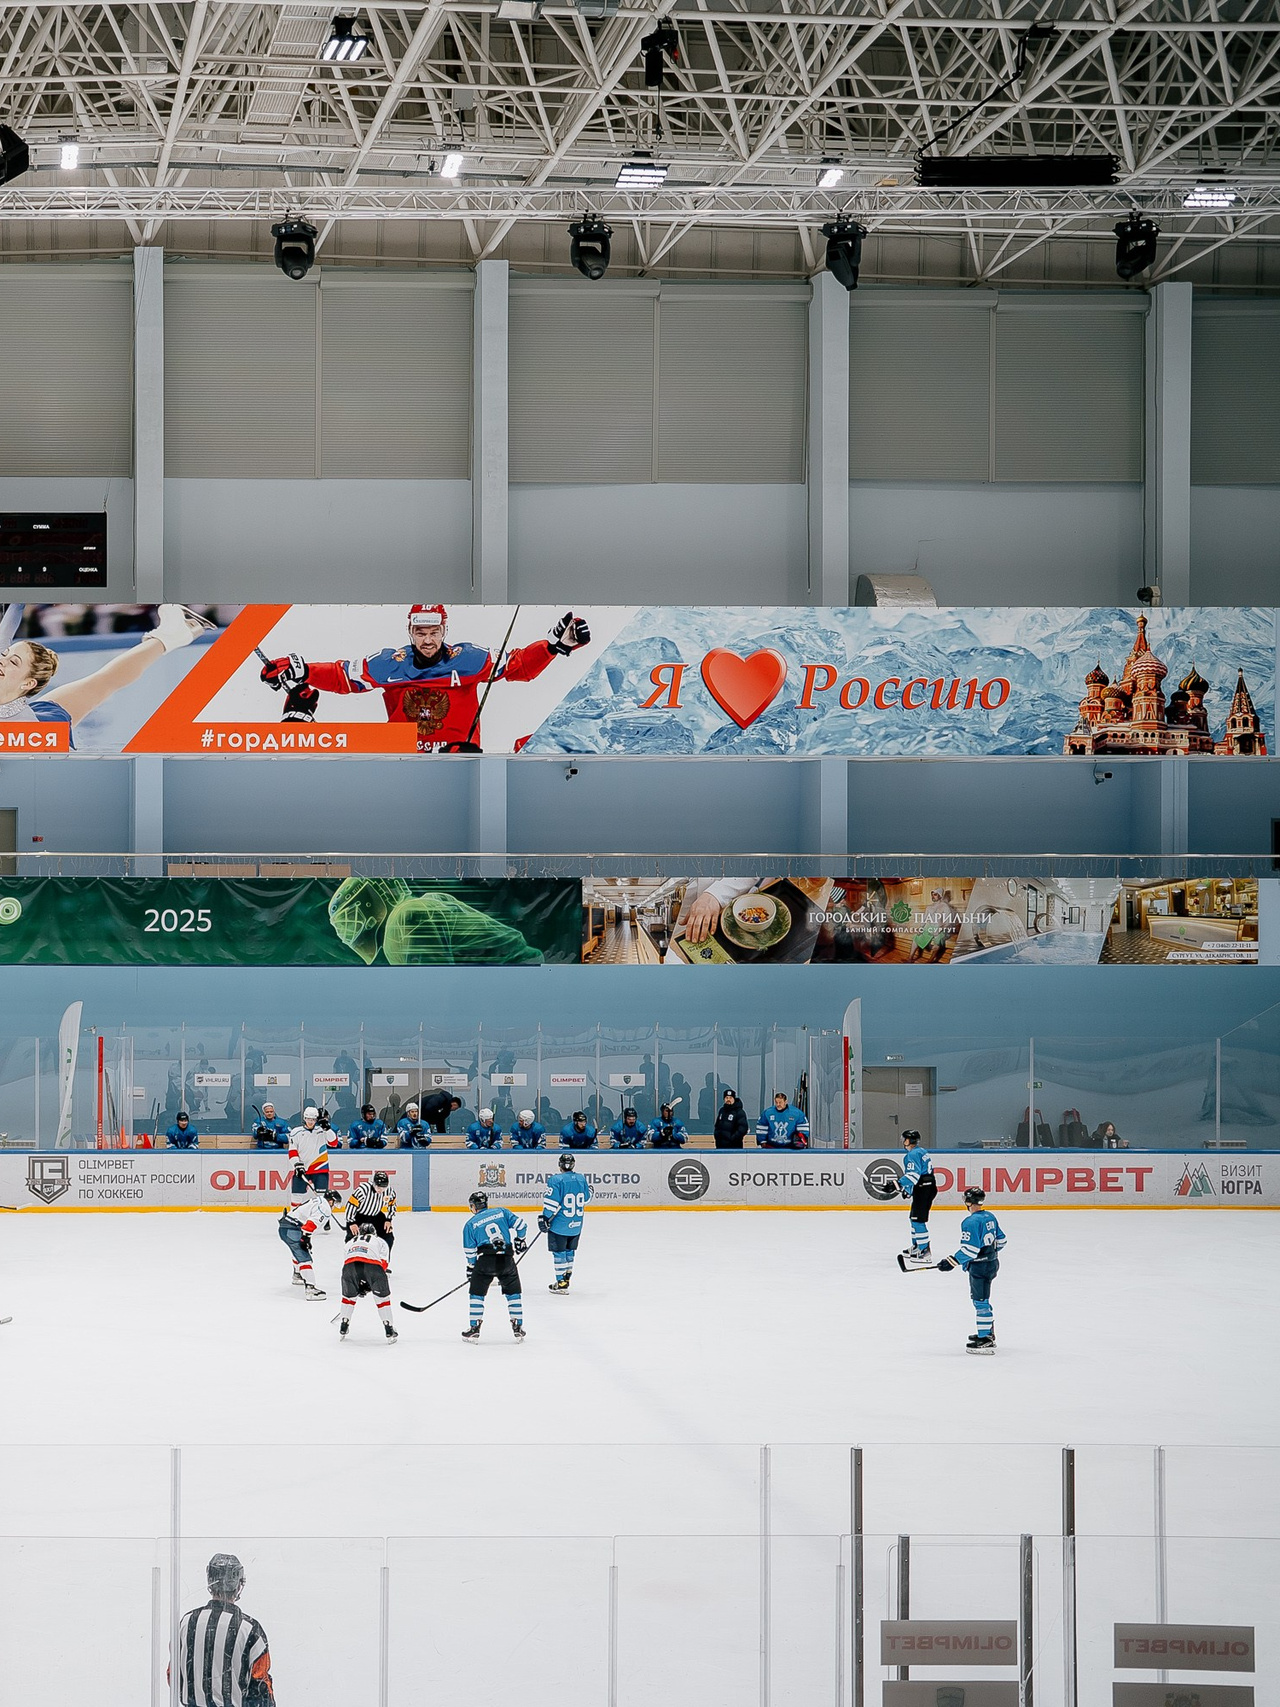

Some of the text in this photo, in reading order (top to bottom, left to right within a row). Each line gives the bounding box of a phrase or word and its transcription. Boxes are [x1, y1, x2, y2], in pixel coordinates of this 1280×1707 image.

[638, 663, 691, 709] Я
[794, 663, 1010, 711] Россию
[201, 728, 348, 751] #гордимся
[144, 909, 212, 933] 2025
[809, 912, 993, 924] ГОРОДСКИЕ ПАРИЛЬНИ
[78, 1159, 134, 1170] OLIMPBET
[1222, 1165, 1262, 1177] ВИЗИТ
[78, 1174, 148, 1185] ЧЕМПИОНАТ
[150, 1174, 195, 1184] РОССИИ
[728, 1172, 844, 1187] SPORTDE.RU
[933, 1167, 1154, 1193] OLIMPBET
[78, 1188, 144, 1200] ПО ХОККЕЮ
[1222, 1180, 1262, 1195] ЮГРА
[563, 1193, 584, 1218] 99
